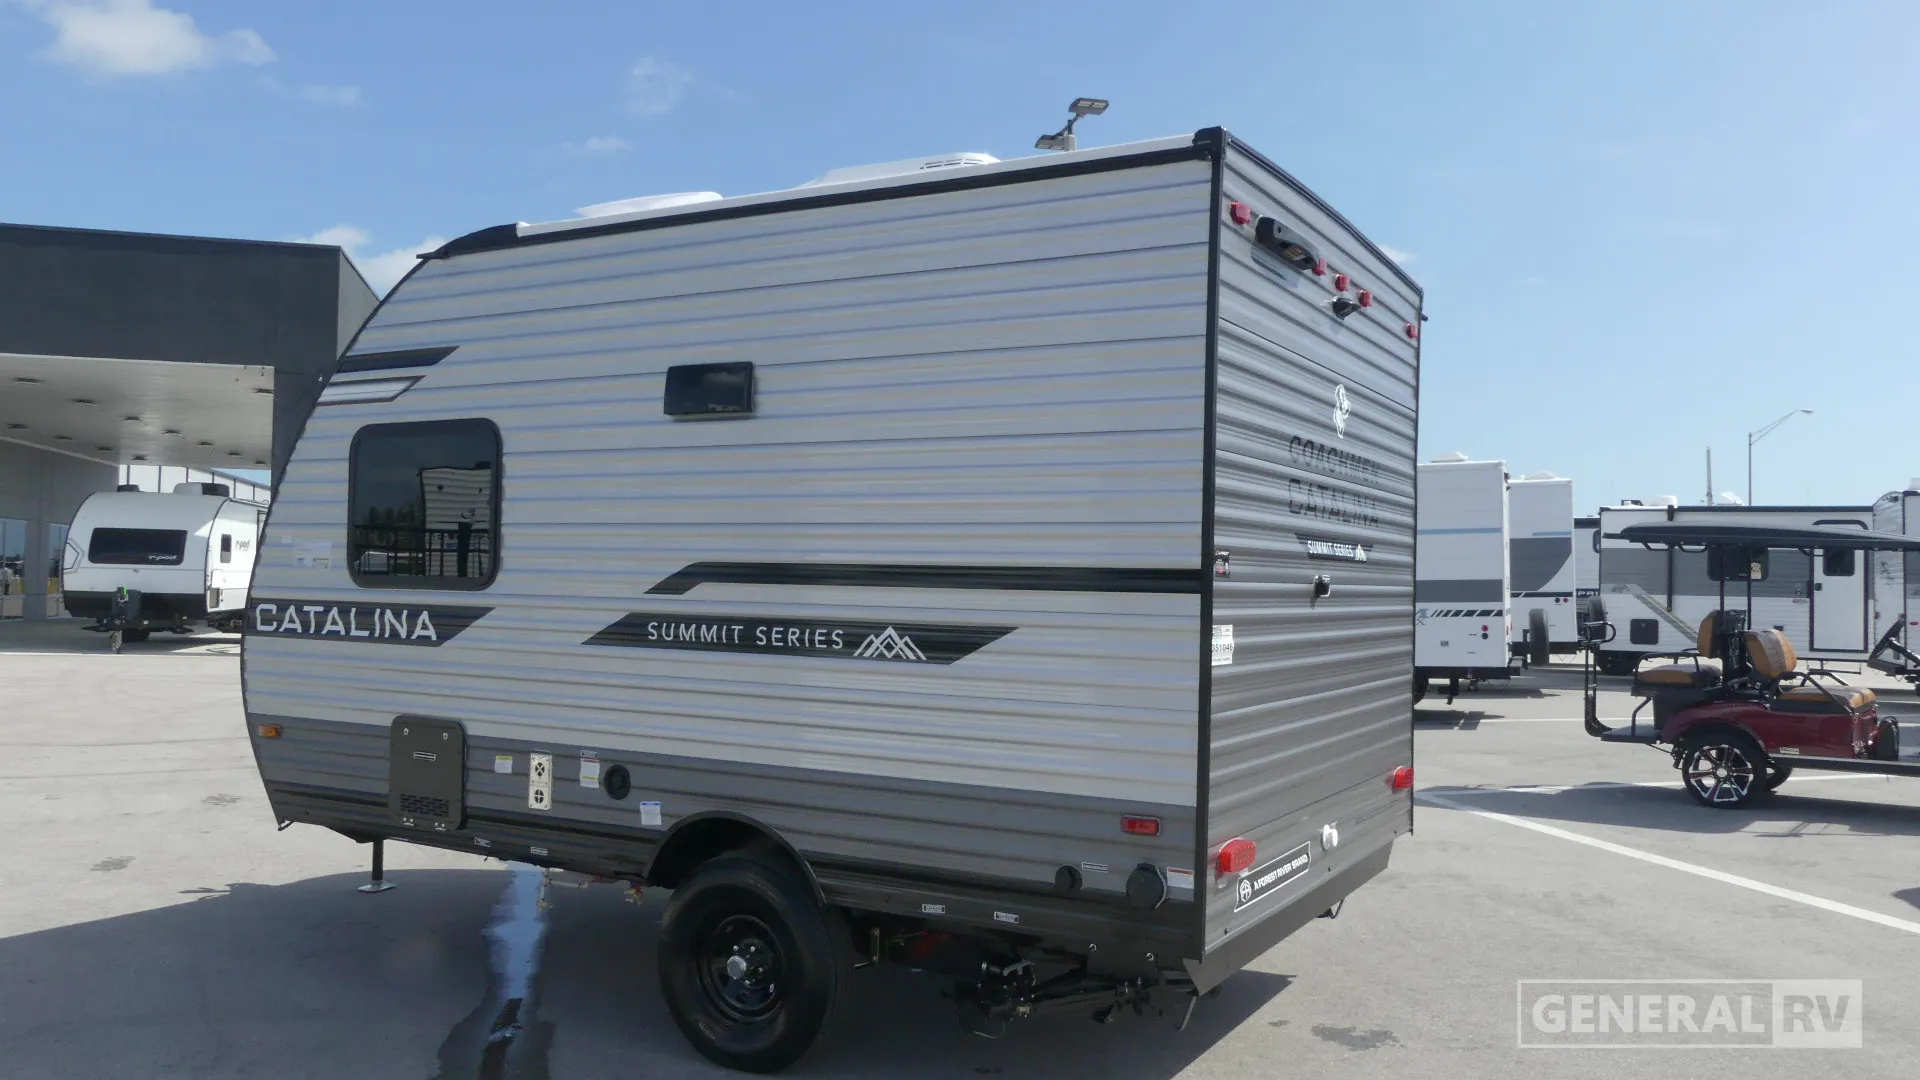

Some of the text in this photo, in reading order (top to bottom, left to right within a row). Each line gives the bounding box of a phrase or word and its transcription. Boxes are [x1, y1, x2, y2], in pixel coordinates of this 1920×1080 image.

[1289, 435, 1380, 484] COACHMEN
[1288, 478, 1379, 528] CATALINA
[1307, 540, 1354, 558] SUMMIT SERIES
[255, 603, 437, 641] CATALINA
[647, 621, 845, 650] SUMMIT SERIES
[1258, 871, 1277, 888] FOREST
[1277, 863, 1292, 877] RIVER
[1291, 854, 1308, 869] BRAND
